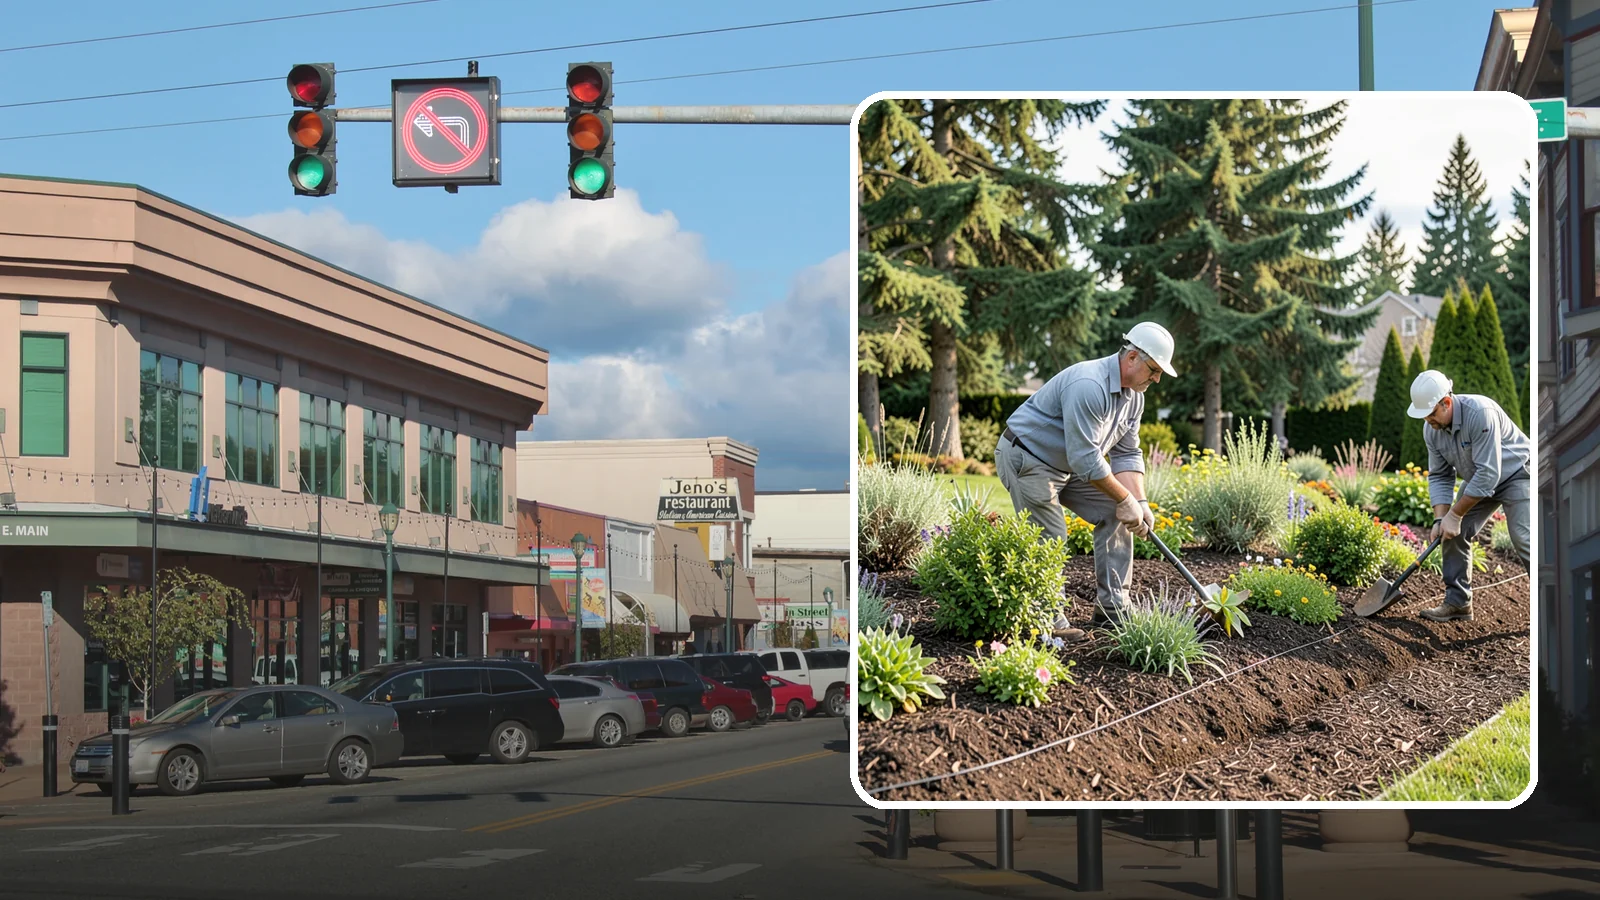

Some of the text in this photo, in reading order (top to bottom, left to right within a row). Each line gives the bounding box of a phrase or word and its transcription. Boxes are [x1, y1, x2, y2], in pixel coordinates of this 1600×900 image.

[669, 479, 727, 494] Jeno's
[665, 496, 731, 509] restaurant
[658, 510, 681, 519] Italian
[686, 510, 714, 519] American
[715, 509, 737, 519] Cuisine
[2, 525, 49, 536] E. MAIN
[797, 607, 828, 617] Street
[790, 619, 823, 627] lass
